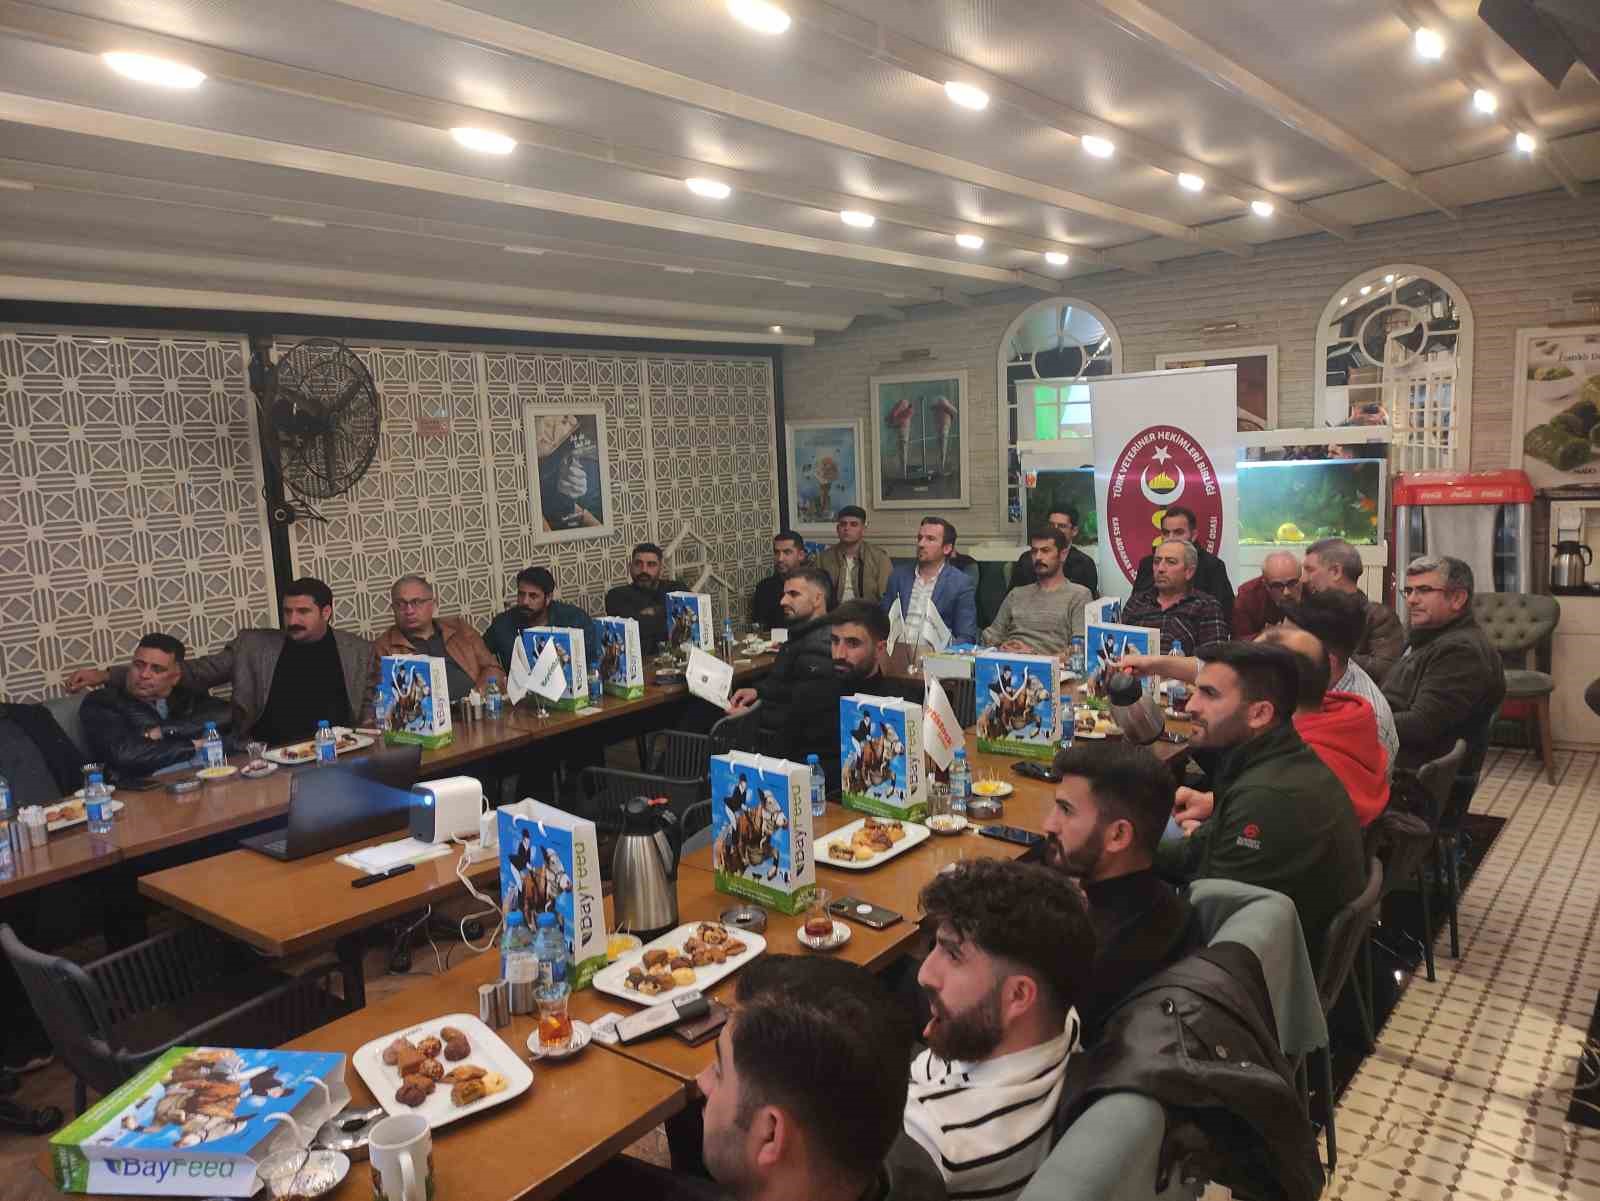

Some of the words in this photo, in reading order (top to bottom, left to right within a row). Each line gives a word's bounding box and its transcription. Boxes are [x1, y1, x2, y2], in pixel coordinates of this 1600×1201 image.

[1119, 432, 1156, 473] VETERİNER
[1157, 431, 1204, 463] HEKİMLERİ
[1113, 473, 1126, 498] TÜRK
[1197, 462, 1216, 496] BİRLİĞİ
[575, 842, 594, 932] BayFeed
[122, 1158, 235, 1183] BayFeed
